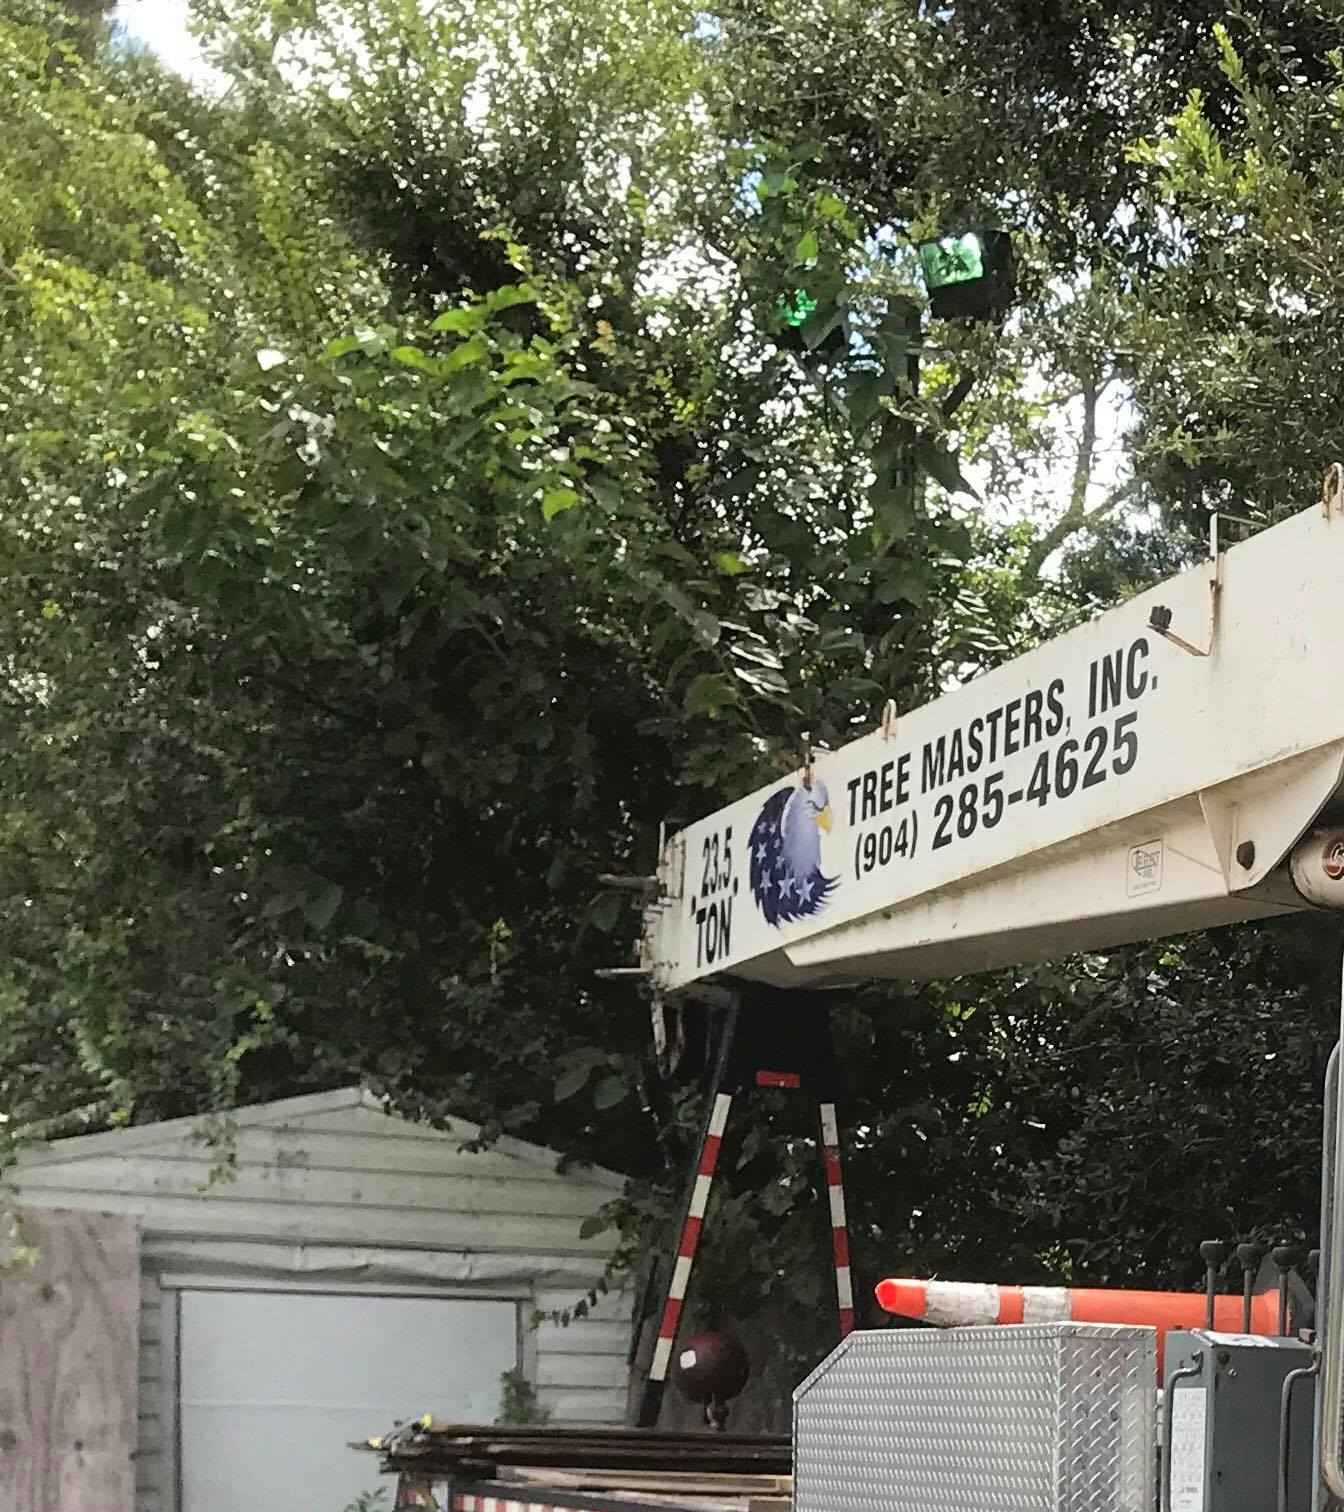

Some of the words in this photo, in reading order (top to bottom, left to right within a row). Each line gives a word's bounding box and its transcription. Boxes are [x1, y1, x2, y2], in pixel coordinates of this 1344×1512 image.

[847, 752, 912, 827] TREE
[921, 677, 1072, 794] MASTERS,
[1088, 637, 1159, 719] INC.
[855, 809, 919, 881] (904)
[931, 711, 1139, 851] 285-4625
[695, 895, 733, 969] TON
